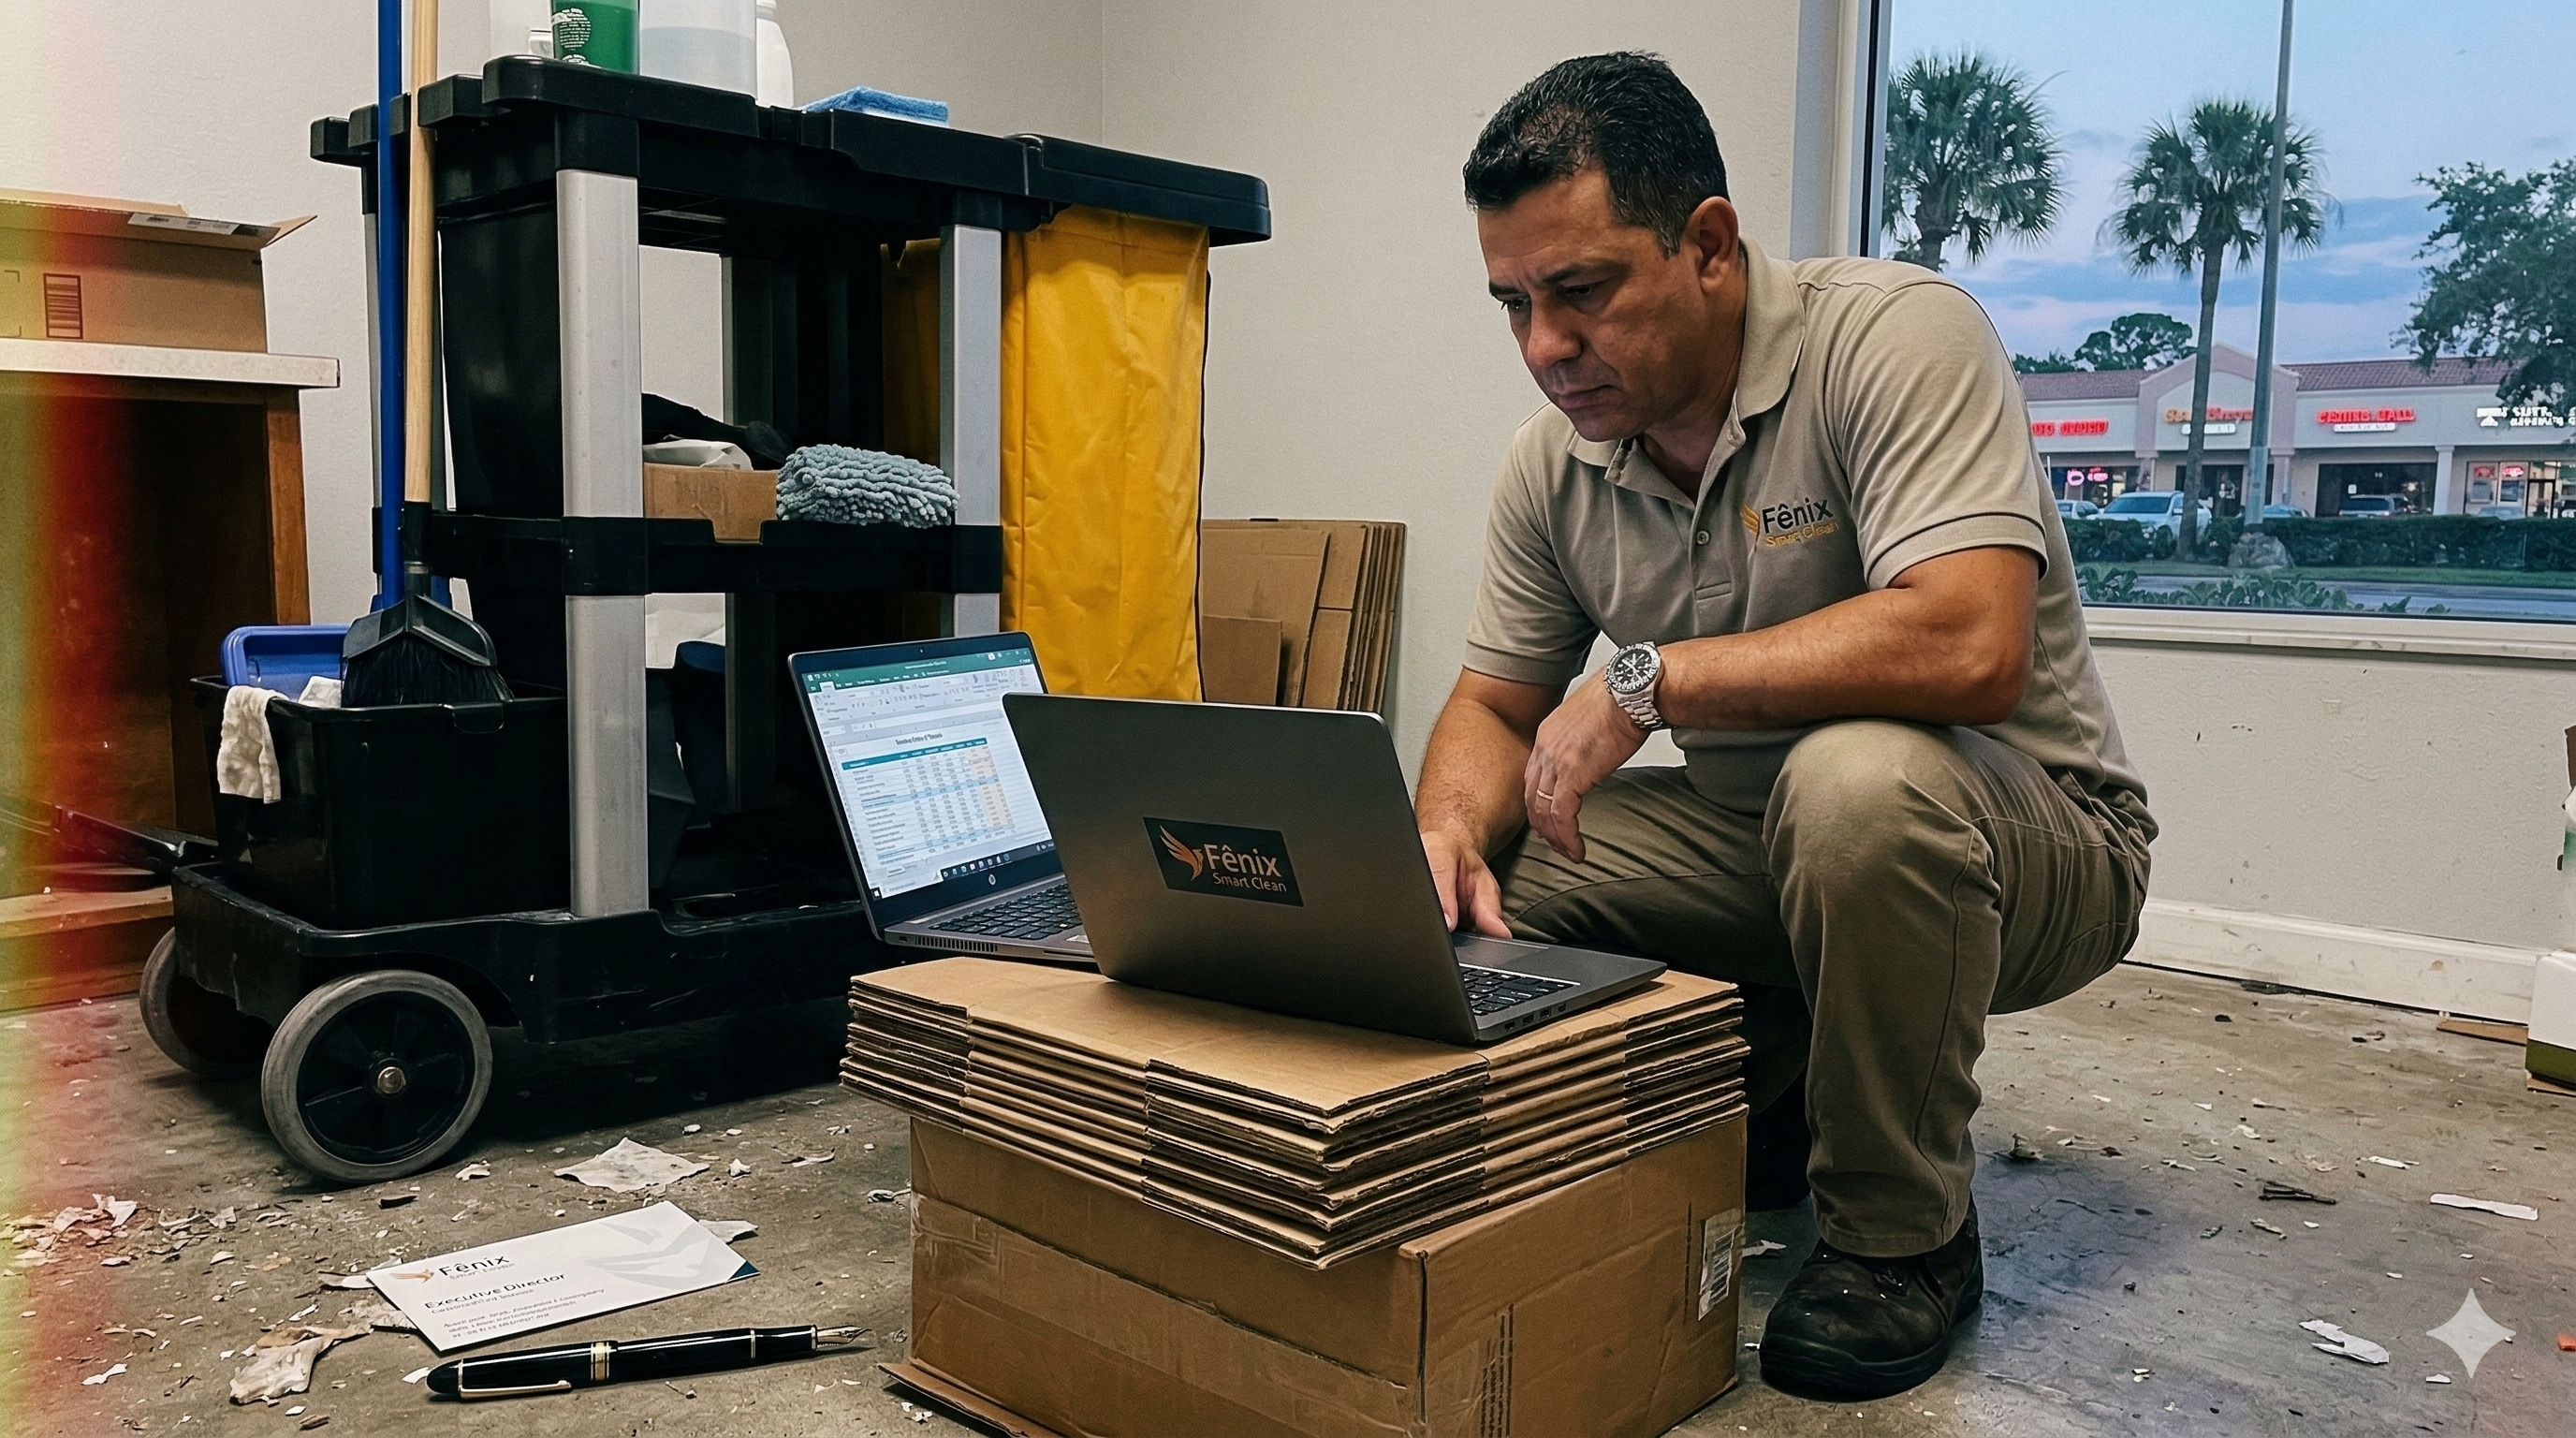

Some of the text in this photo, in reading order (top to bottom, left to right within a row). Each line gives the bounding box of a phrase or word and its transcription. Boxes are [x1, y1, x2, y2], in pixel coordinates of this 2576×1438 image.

[1762, 497, 1834, 534] Fênix
[1204, 844, 1281, 877] Fênix
[1212, 873, 1287, 892] Smart Clean
[438, 1255, 510, 1276] Fênix
[424, 1288, 502, 1309] Executive
[504, 1273, 565, 1292] Director
